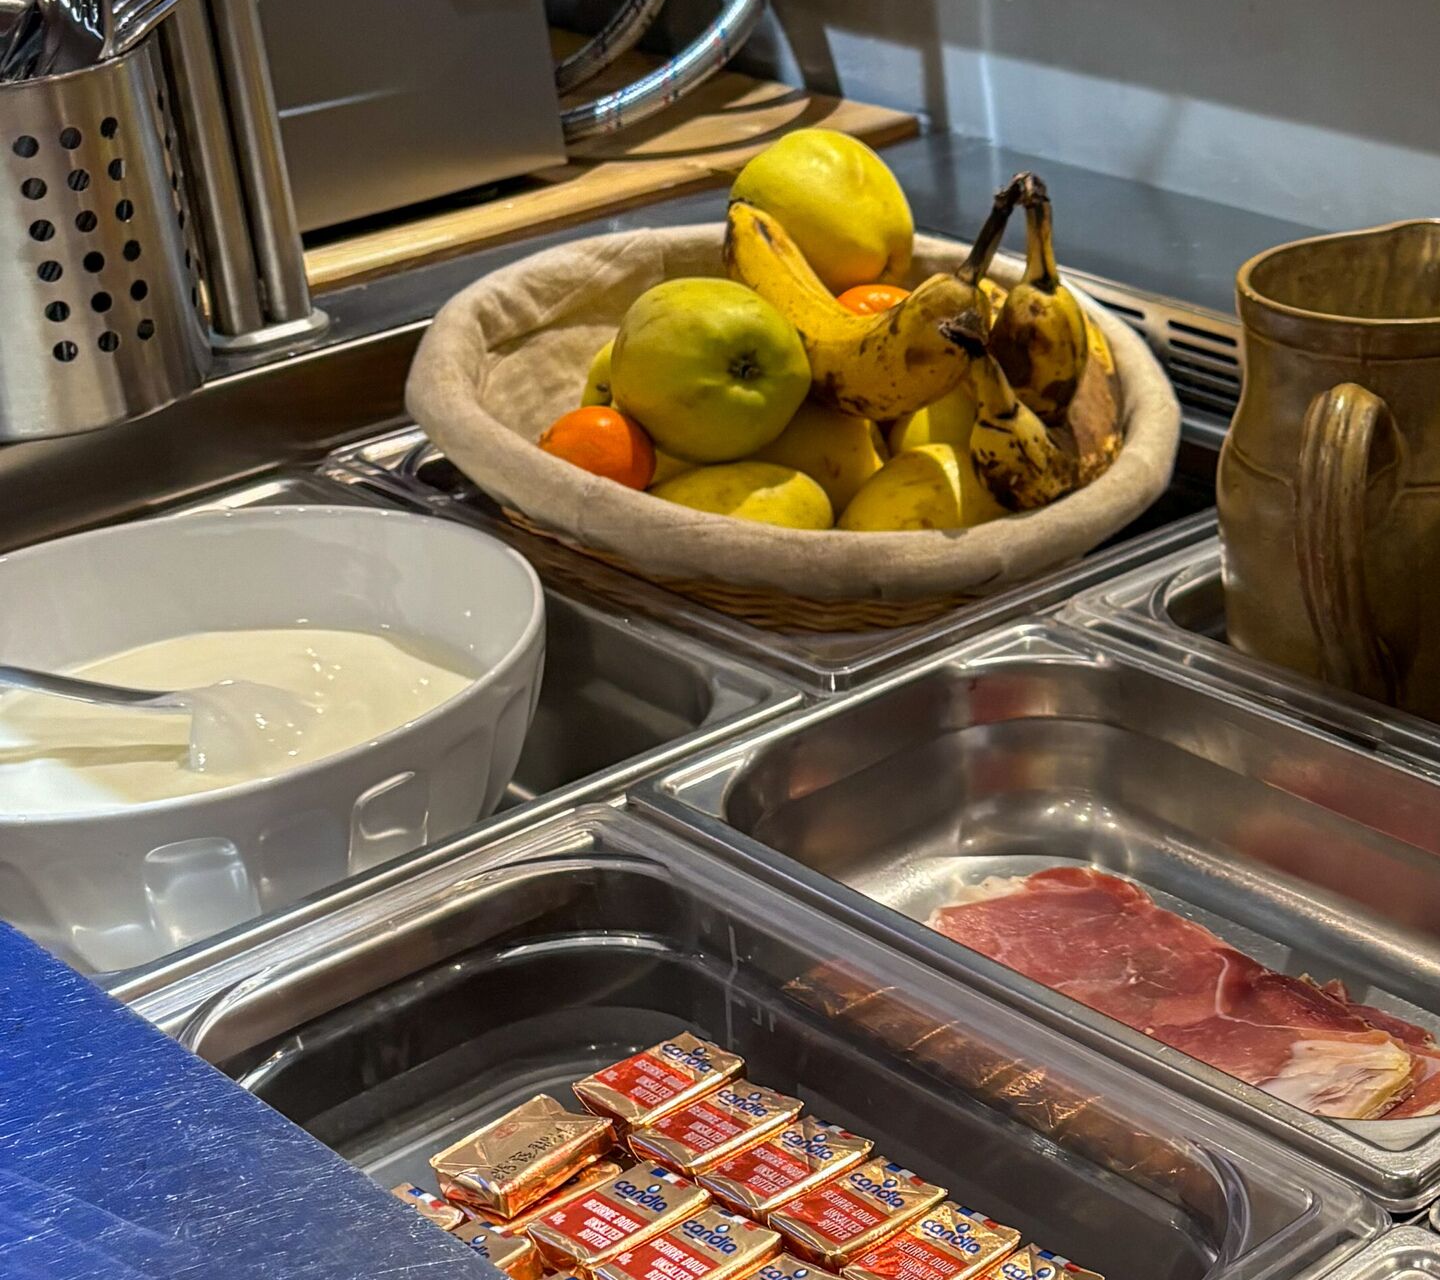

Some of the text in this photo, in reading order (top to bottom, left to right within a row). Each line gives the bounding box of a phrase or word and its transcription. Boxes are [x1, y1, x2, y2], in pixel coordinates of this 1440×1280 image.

[782, 1130, 833, 1160] candia
[614, 1180, 668, 1212] candia
[850, 1172, 905, 1208] candia
[683, 1220, 737, 1254] candia
[922, 1220, 981, 1254] candia
[895, 1240, 959, 1275] BEURRE DOUX
